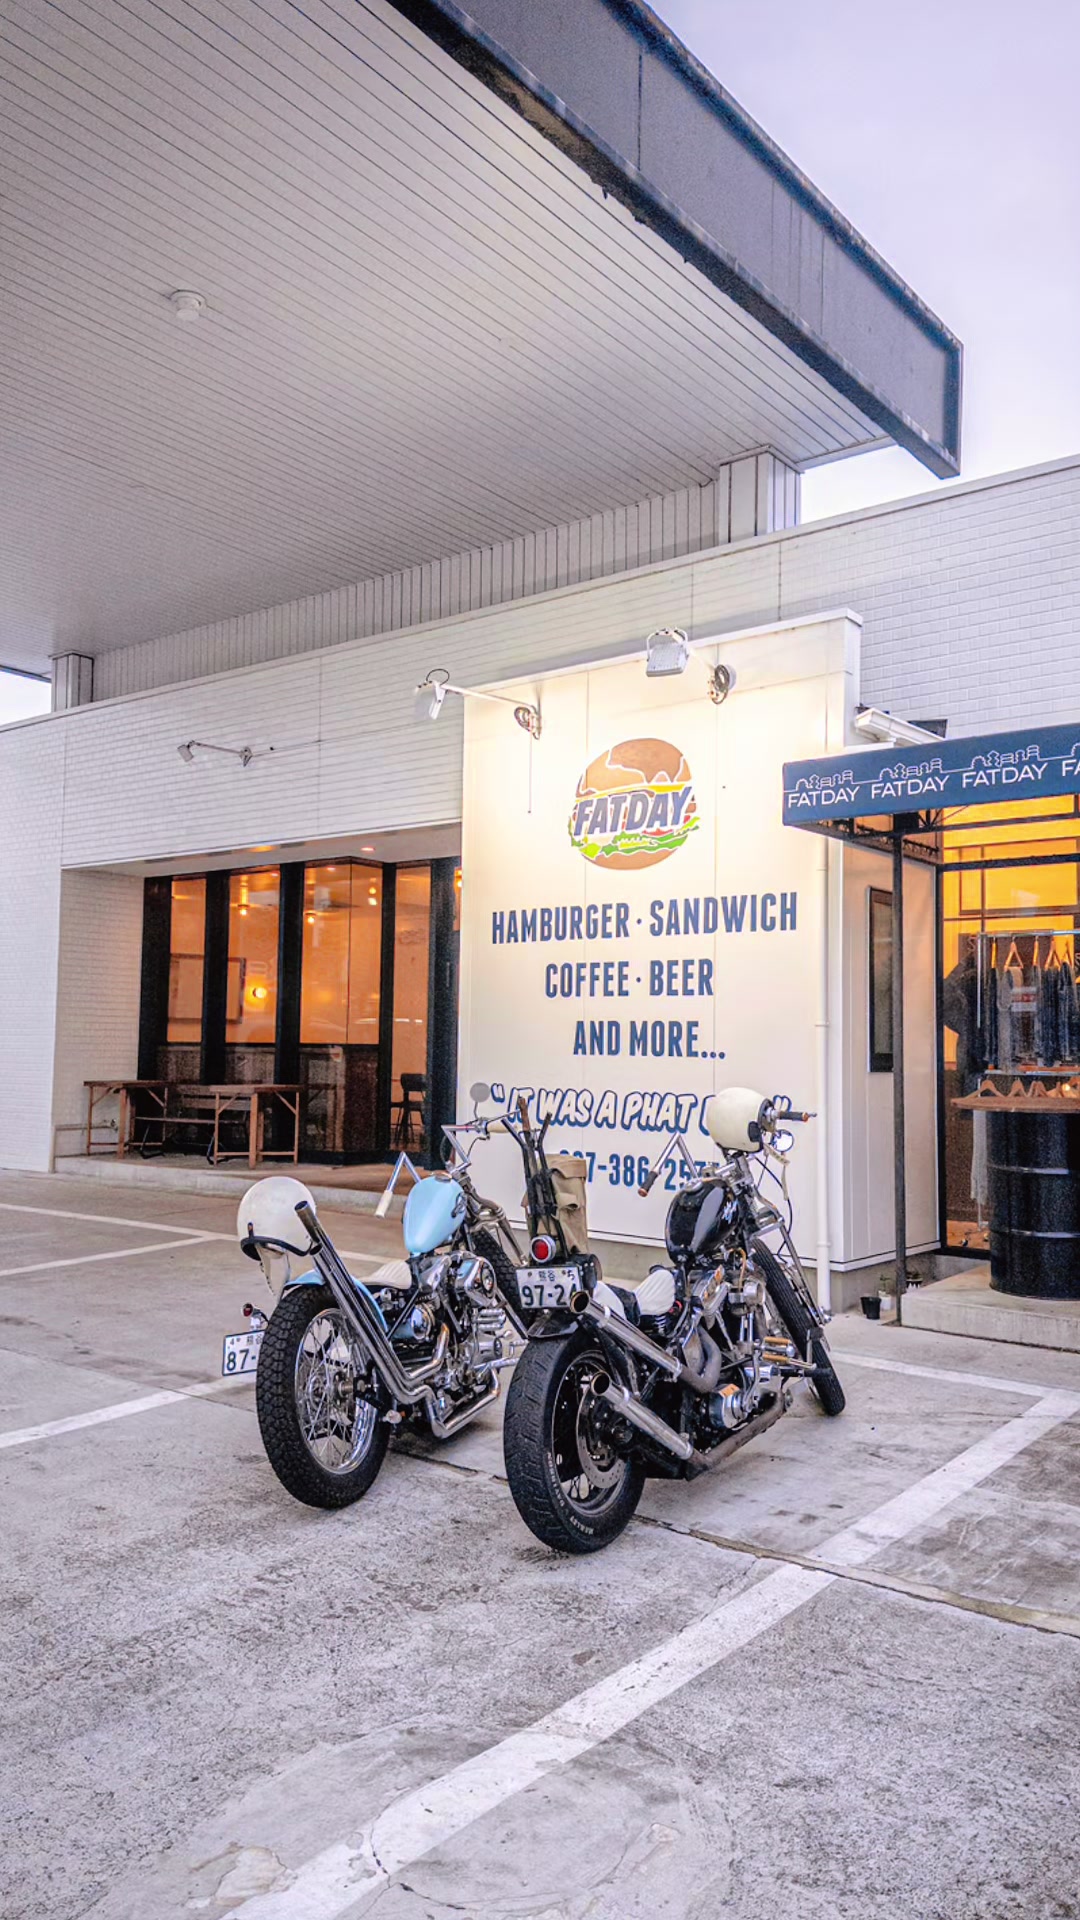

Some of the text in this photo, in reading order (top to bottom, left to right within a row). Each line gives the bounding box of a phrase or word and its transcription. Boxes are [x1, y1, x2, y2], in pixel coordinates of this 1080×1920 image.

[788, 786, 860, 808] FATDAY
[871, 775, 949, 799] FATDAY
[962, 762, 1048, 788] FATDAY
[573, 786, 692, 836] FATDAY
[492, 892, 797, 944] HAMBURGER SANDWICH
[545, 958, 714, 998] COFFEE BEER
[573, 1020, 621, 1056] AND
[536, 1088, 594, 1127] WAS
[594, 1090, 617, 1129] A
[621, 1091, 698, 1134] PHAT
